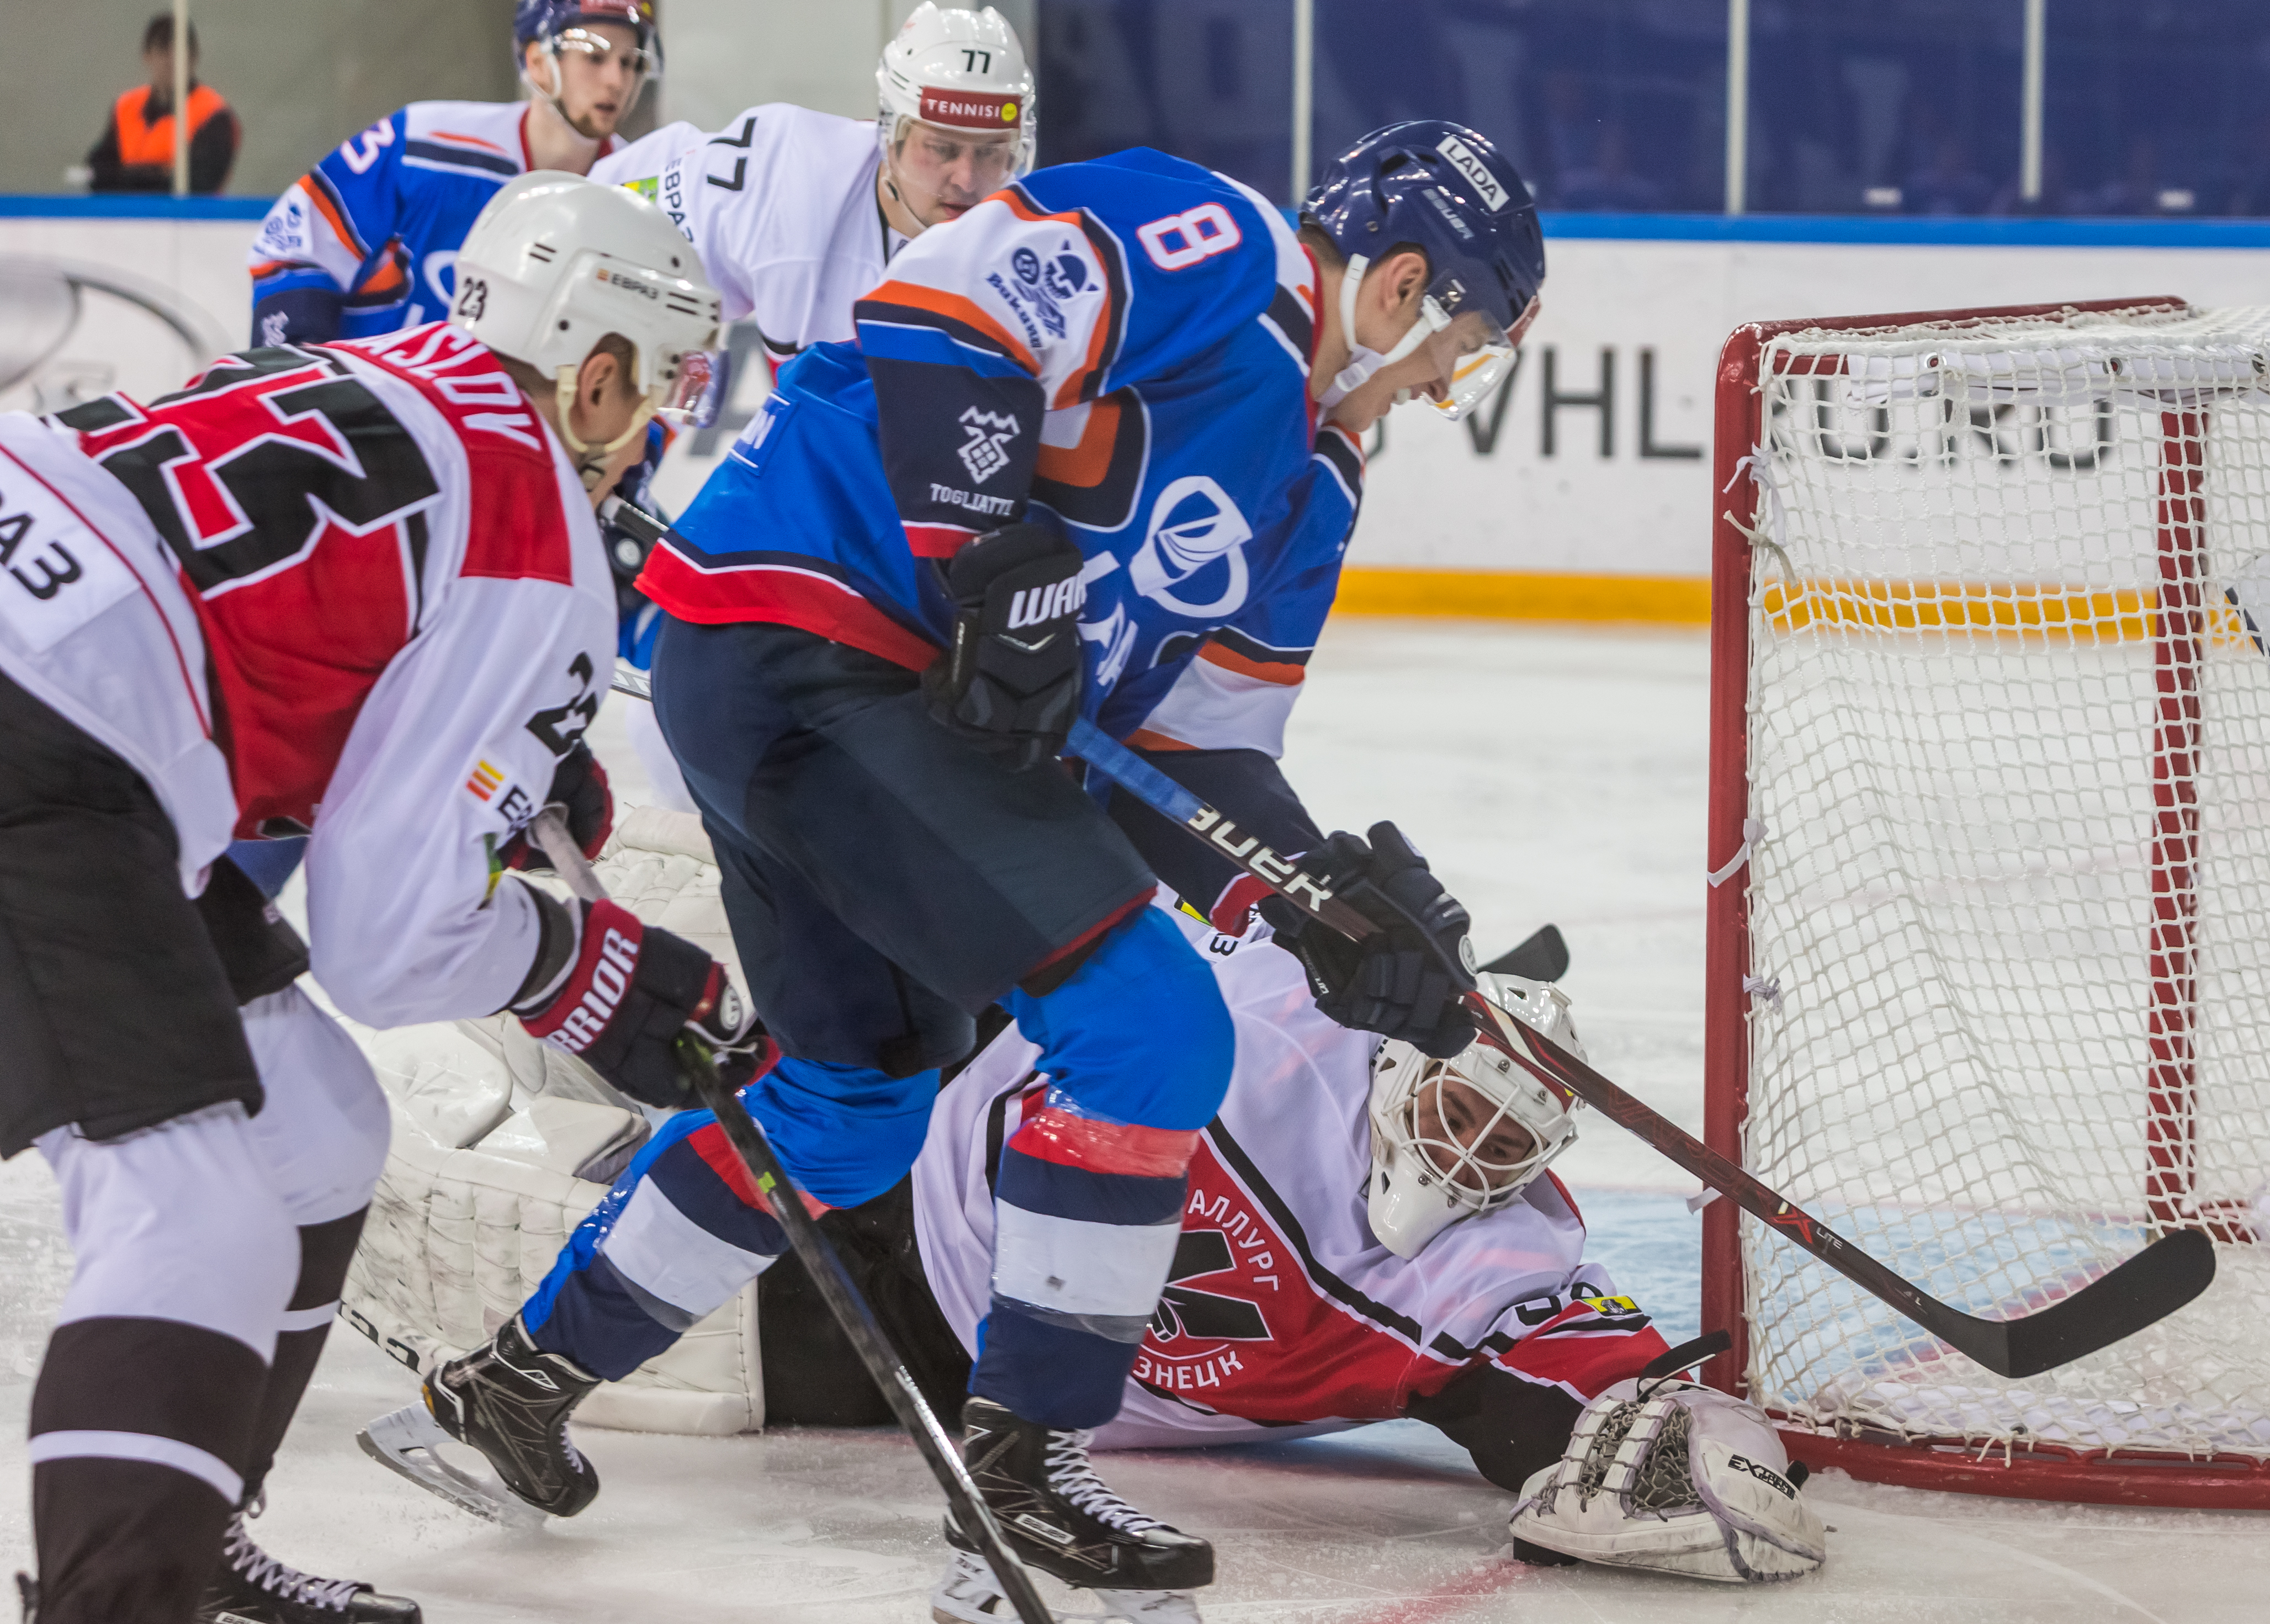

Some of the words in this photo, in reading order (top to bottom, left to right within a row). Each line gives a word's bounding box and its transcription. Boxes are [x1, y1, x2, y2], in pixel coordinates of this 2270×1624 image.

[962, 49, 991, 73] 77
[926, 98, 1000, 119] TENNISI
[706, 115, 758, 192] 77
[1445, 144, 1498, 202] LADA
[1136, 201, 1243, 273] 8
[458, 276, 489, 321] 23
[930, 482, 1015, 516] TOGLIATTI
